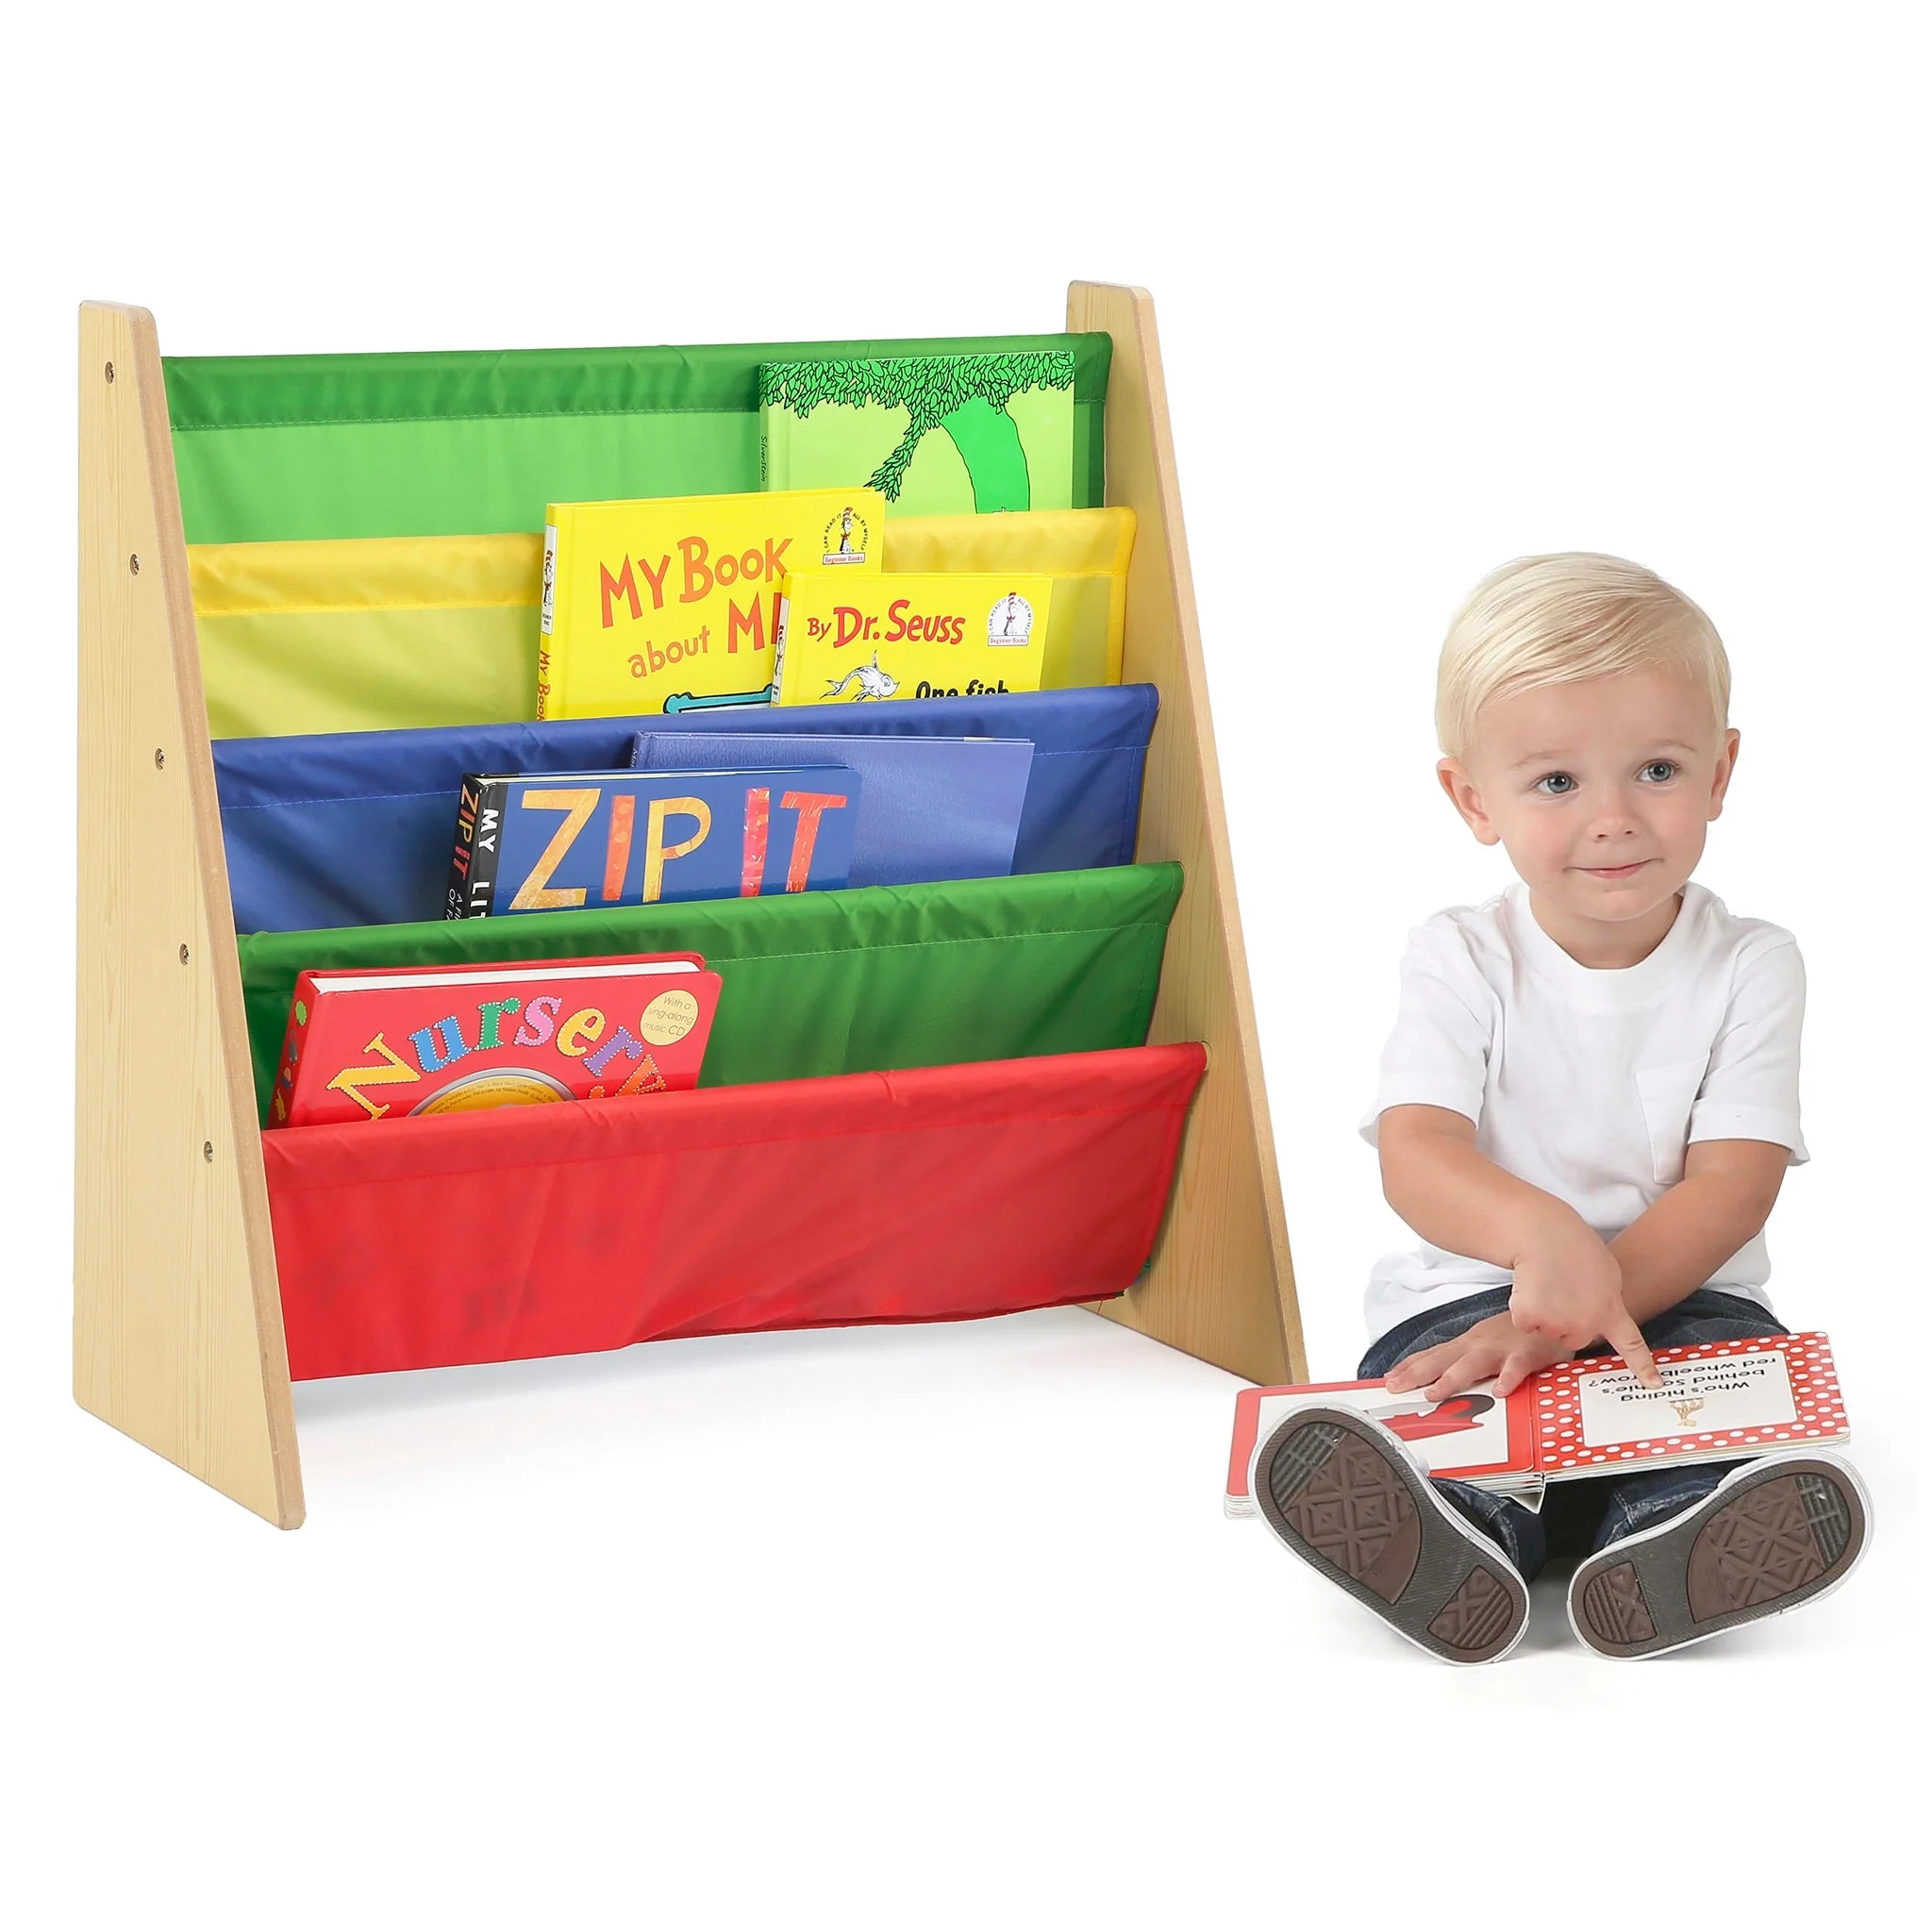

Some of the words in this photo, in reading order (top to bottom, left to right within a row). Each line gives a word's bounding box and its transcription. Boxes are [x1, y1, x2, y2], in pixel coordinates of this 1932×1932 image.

[808, 617, 831, 641] By
[833, 607, 880, 648] Dr.
[885, 599, 966, 645] Seuss
[627, 625, 710, 678] about
[458, 784, 478, 843] ZIP
[478, 808, 499, 853] MY
[508, 788, 712, 910] ZIP
[741, 788, 848, 897] IT
[453, 845, 471, 880] IT
[663, 996, 683, 1008] With
[684, 1002, 691, 1010] a
[646, 1006, 694, 1026] sing-along
[642, 1022, 667, 1033] music
[668, 1024, 686, 1036] CD
[1742, 1357, 1776, 1368] red
[1589, 1362, 1736, 1387] wheelbrow?
[1692, 1369, 1765, 1383] behind
[1602, 1378, 1686, 1394] Sohie's
[1621, 1389, 1685, 1401] hiding
[1691, 1382, 1750, 1393] Who's
